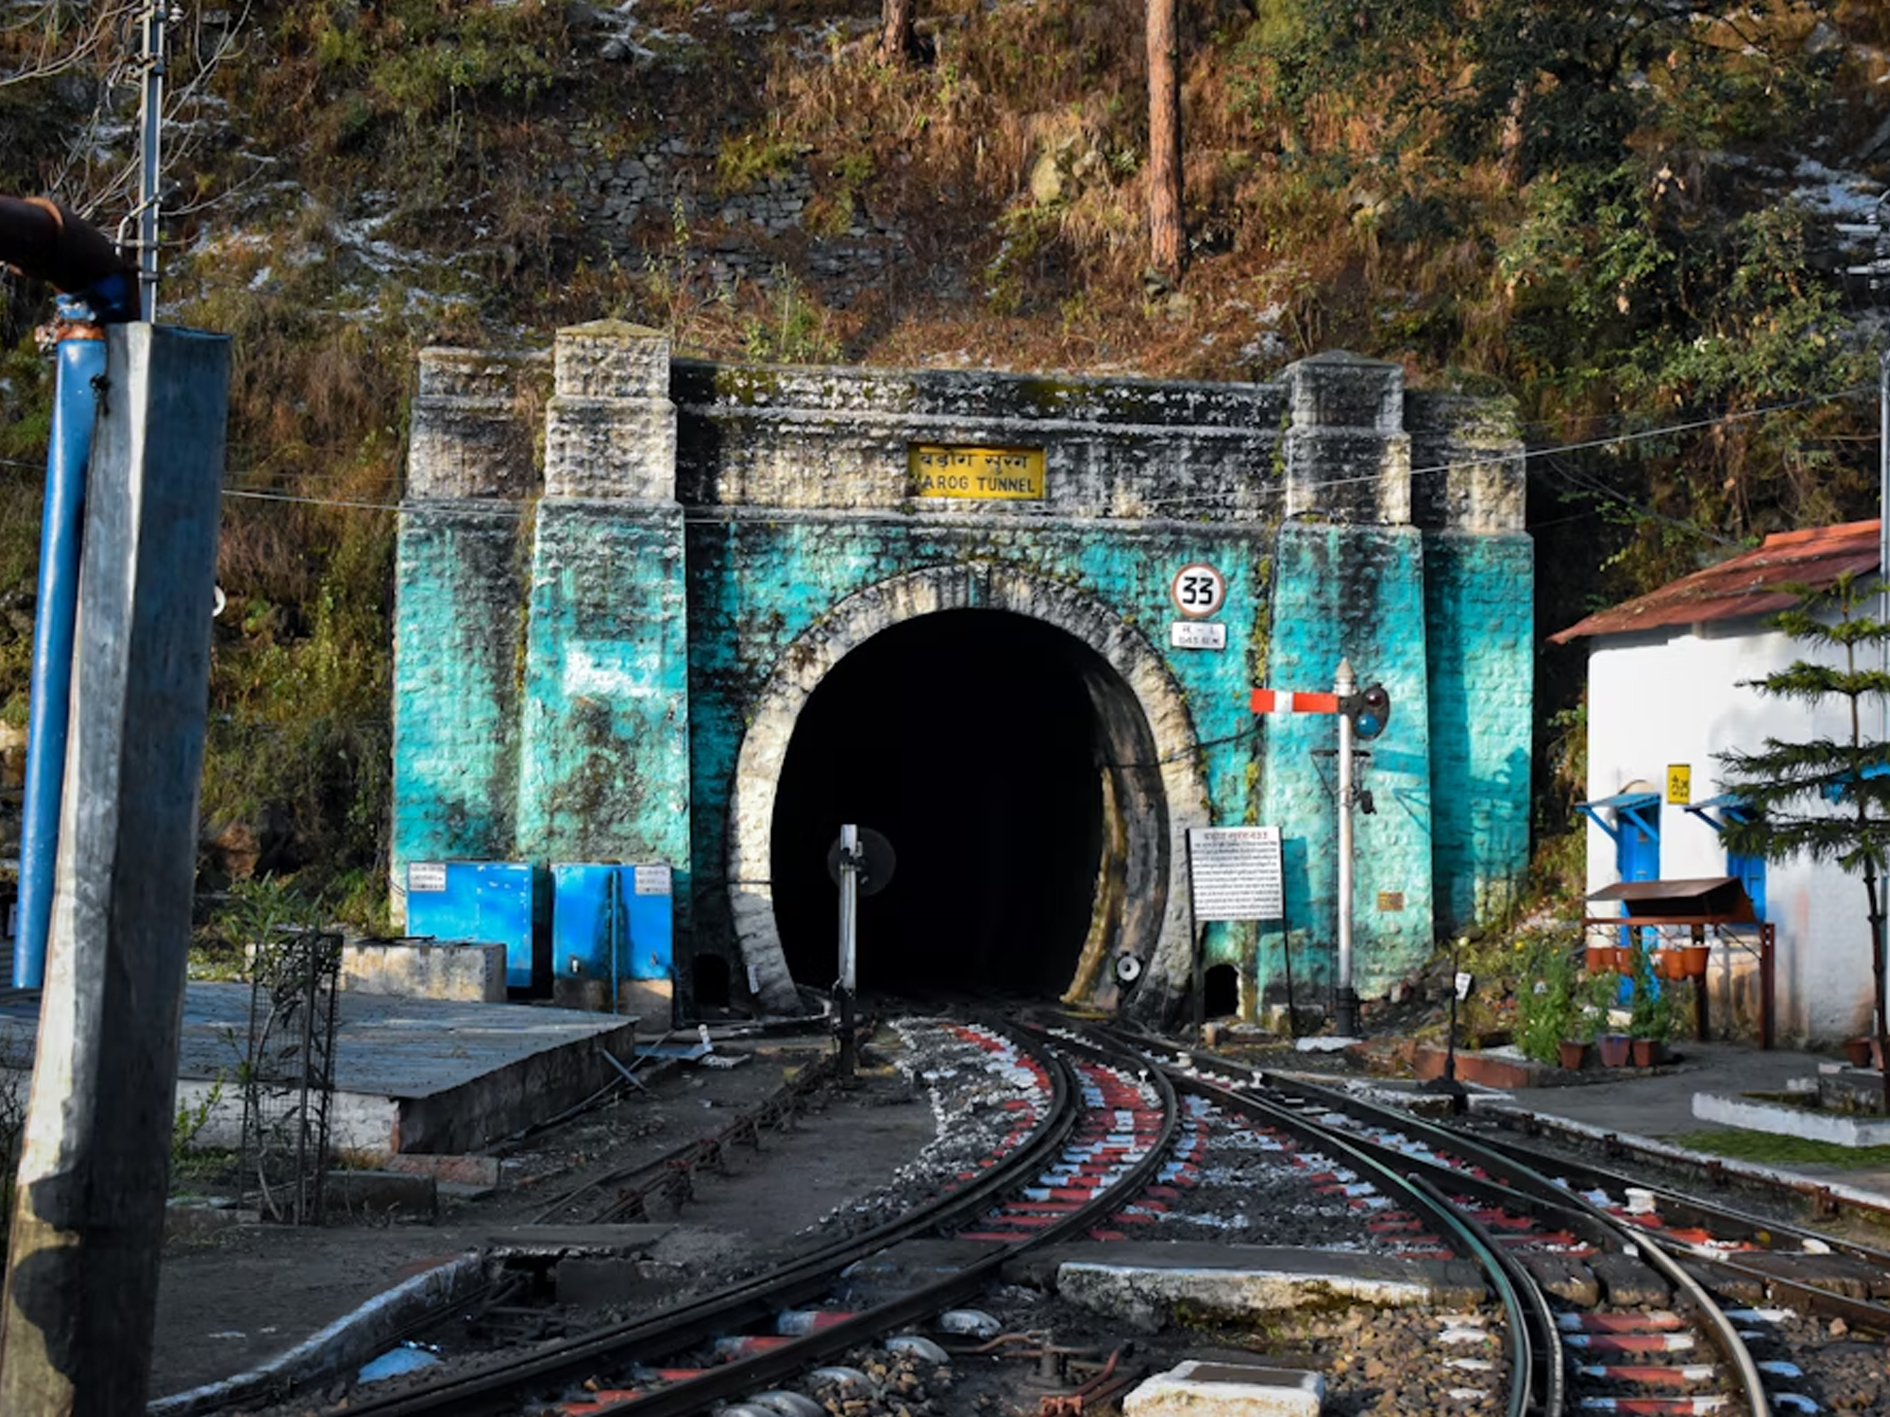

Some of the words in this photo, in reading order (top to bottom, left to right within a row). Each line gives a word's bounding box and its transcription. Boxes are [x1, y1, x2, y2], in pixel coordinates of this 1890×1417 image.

[911, 474, 969, 490] AROG
[976, 476, 1035, 493] TUNNEL
[1182, 576, 1214, 605] 33
